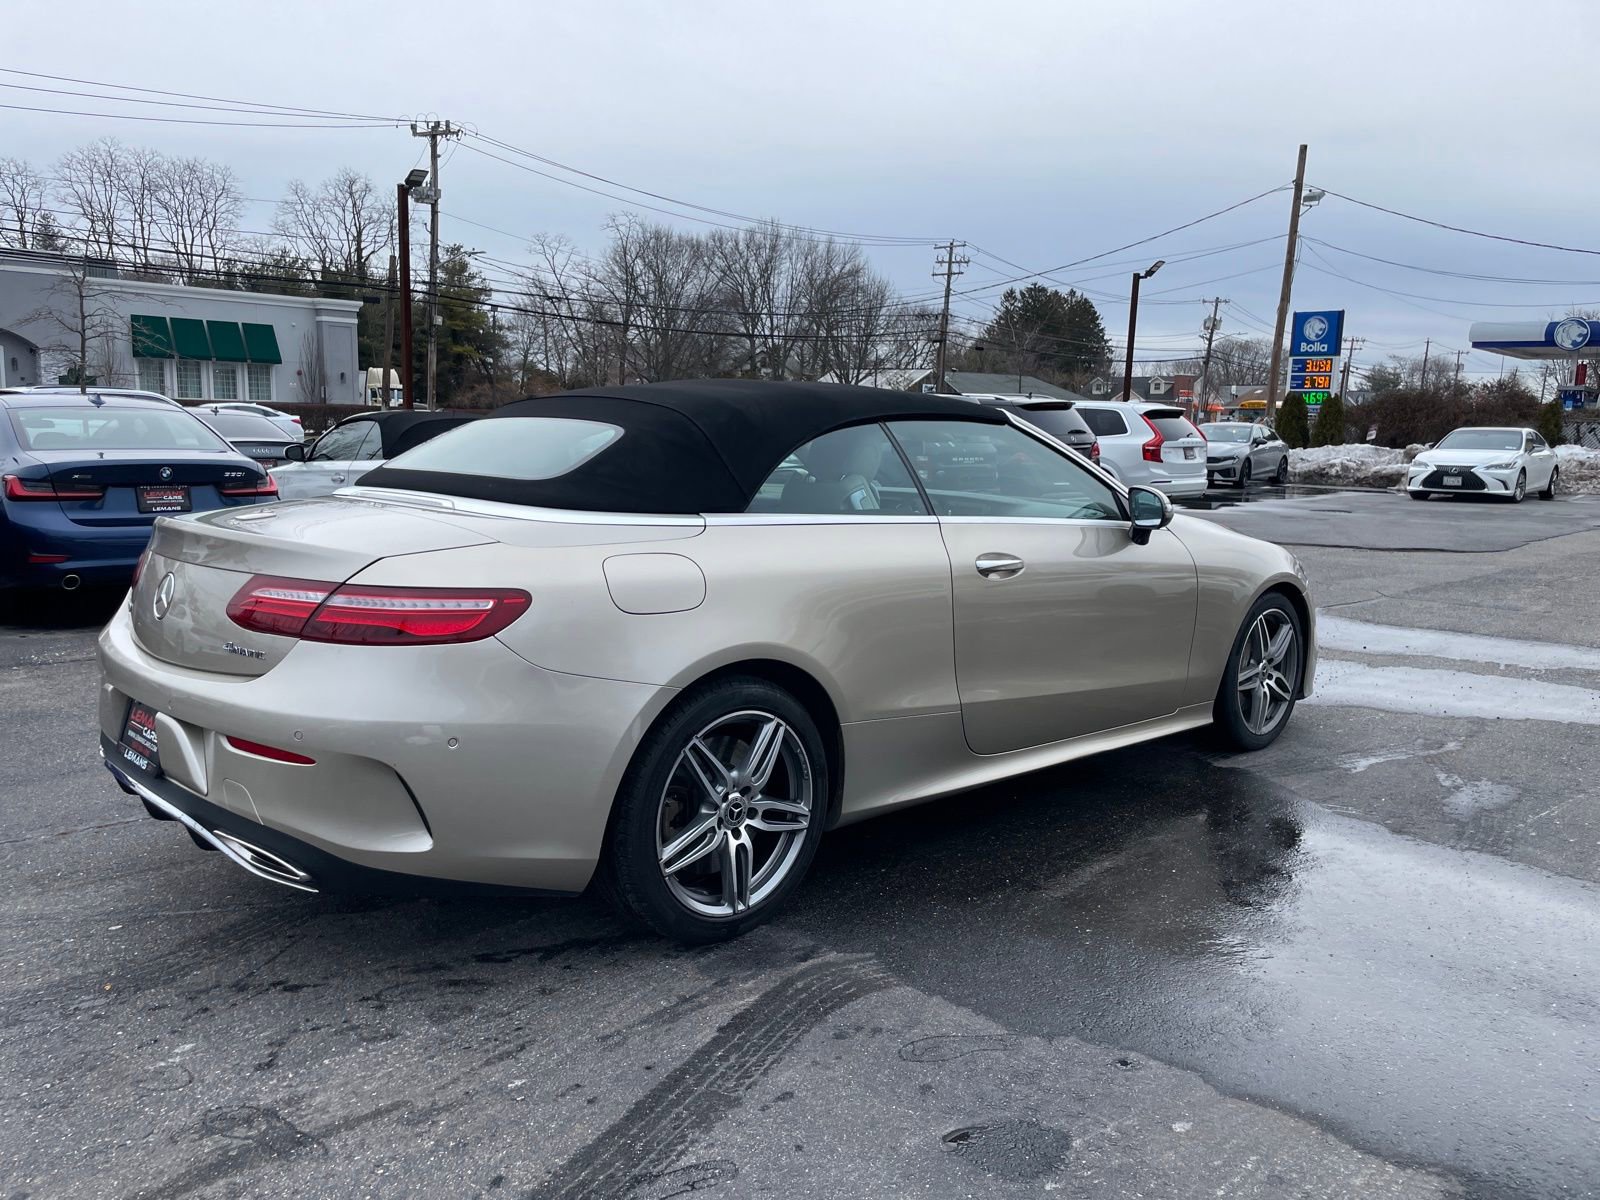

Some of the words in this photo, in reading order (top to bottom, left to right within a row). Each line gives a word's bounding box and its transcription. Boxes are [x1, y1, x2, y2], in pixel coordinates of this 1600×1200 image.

[1300, 342, 1328, 352] Bolla
[130, 706, 156, 731] LEMA
[123, 748, 148, 771] LEMANS
